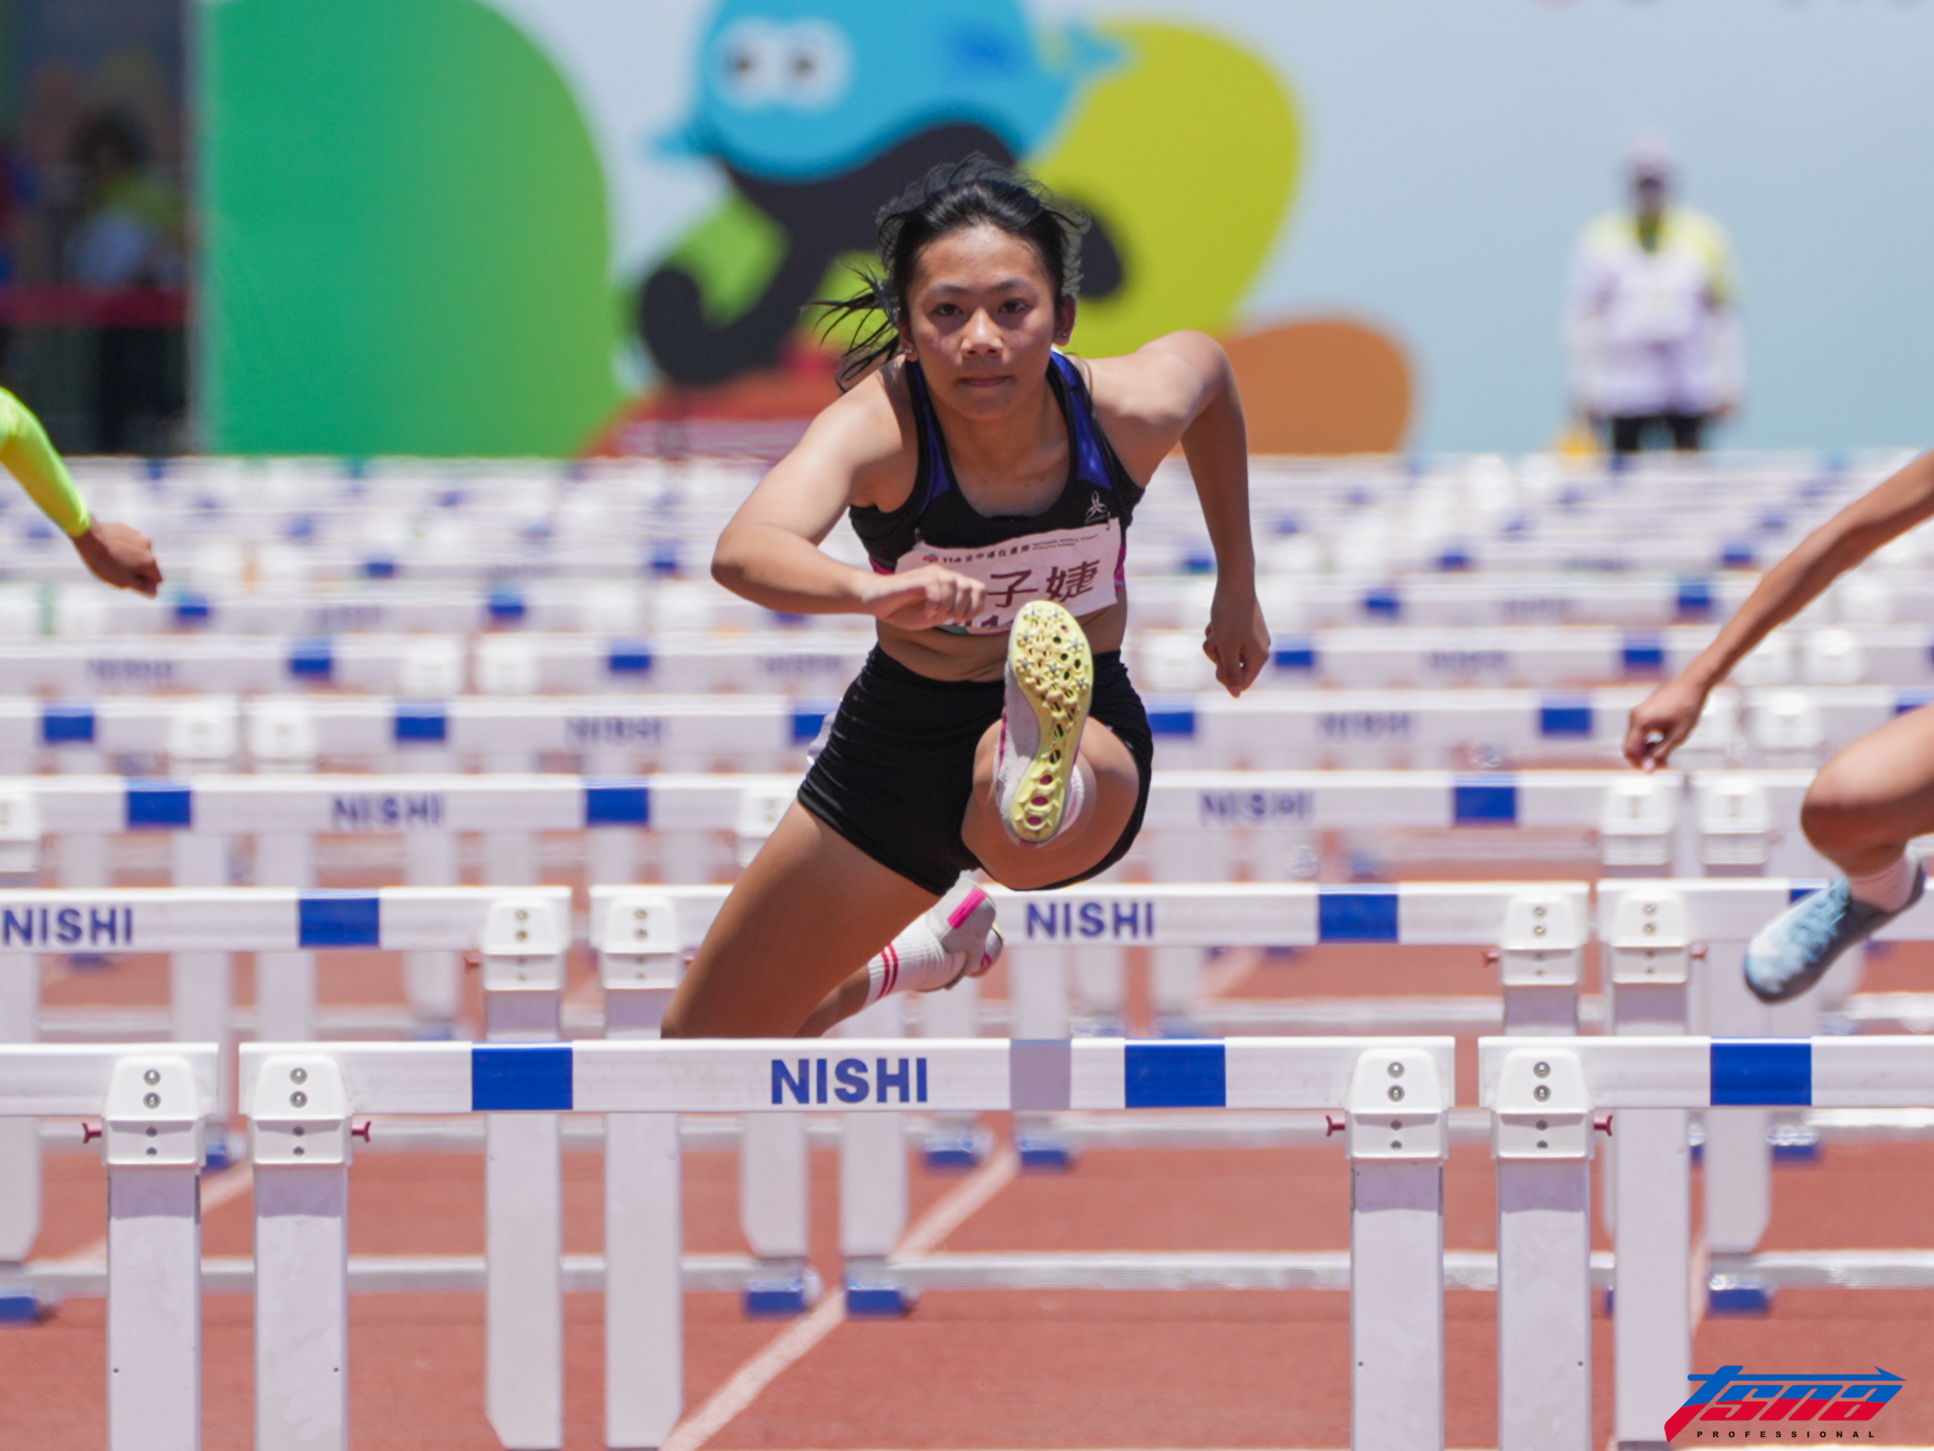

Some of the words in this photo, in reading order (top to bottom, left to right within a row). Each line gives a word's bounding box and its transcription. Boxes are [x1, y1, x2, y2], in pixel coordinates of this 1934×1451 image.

[1, 907, 133, 946] NISHI
[1026, 902, 1154, 938] NISHI
[771, 1058, 928, 1105] NISHI
